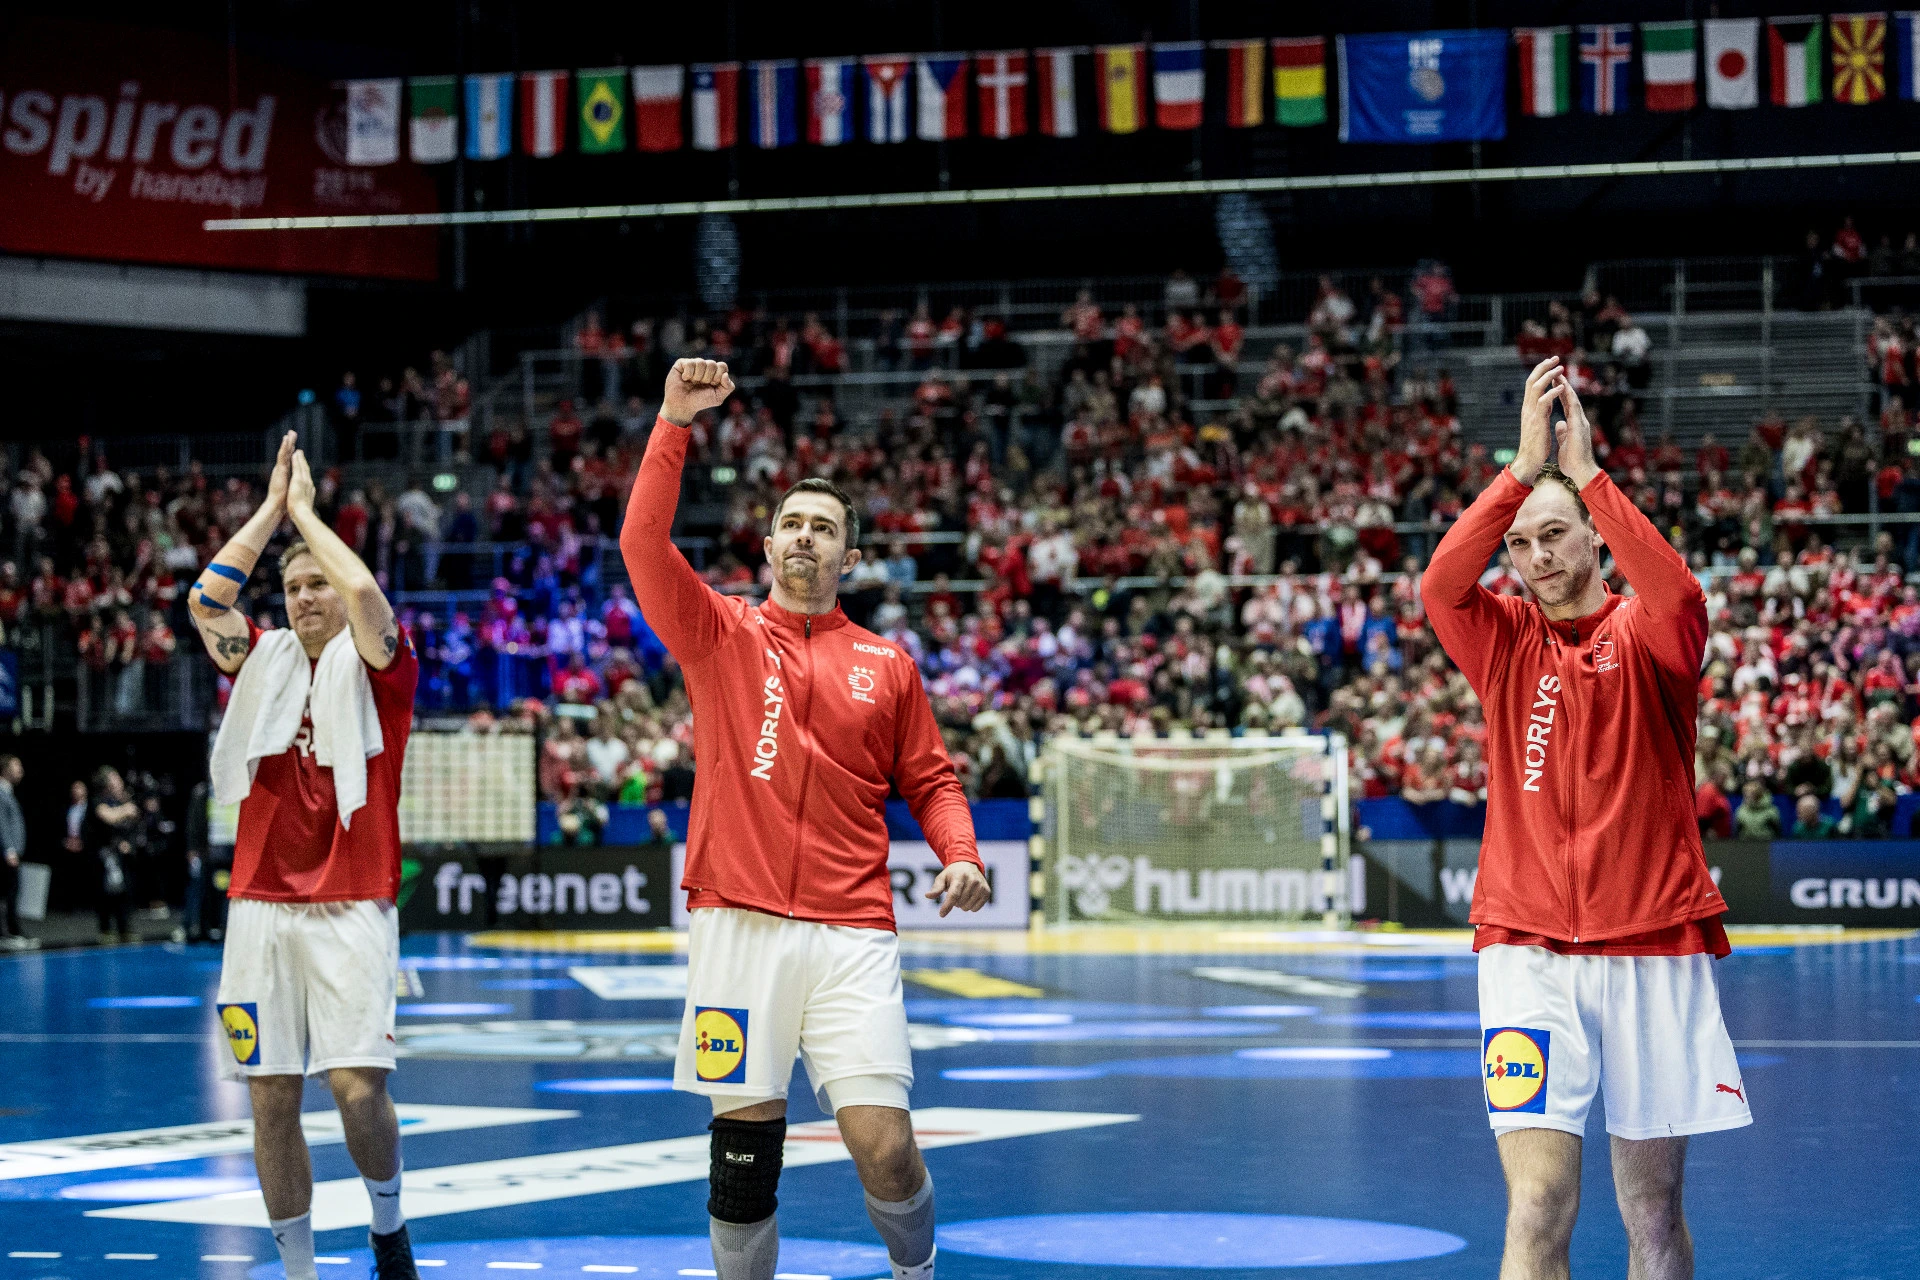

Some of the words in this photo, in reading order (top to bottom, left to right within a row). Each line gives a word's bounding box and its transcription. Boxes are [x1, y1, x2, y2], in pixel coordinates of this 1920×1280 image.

[0, 80, 277, 177] spired
[74, 163, 116, 203] by
[853, 641, 896, 659] NORLYS
[751, 675, 784, 781] NORLYS
[1523, 674, 1562, 792] NORLYS
